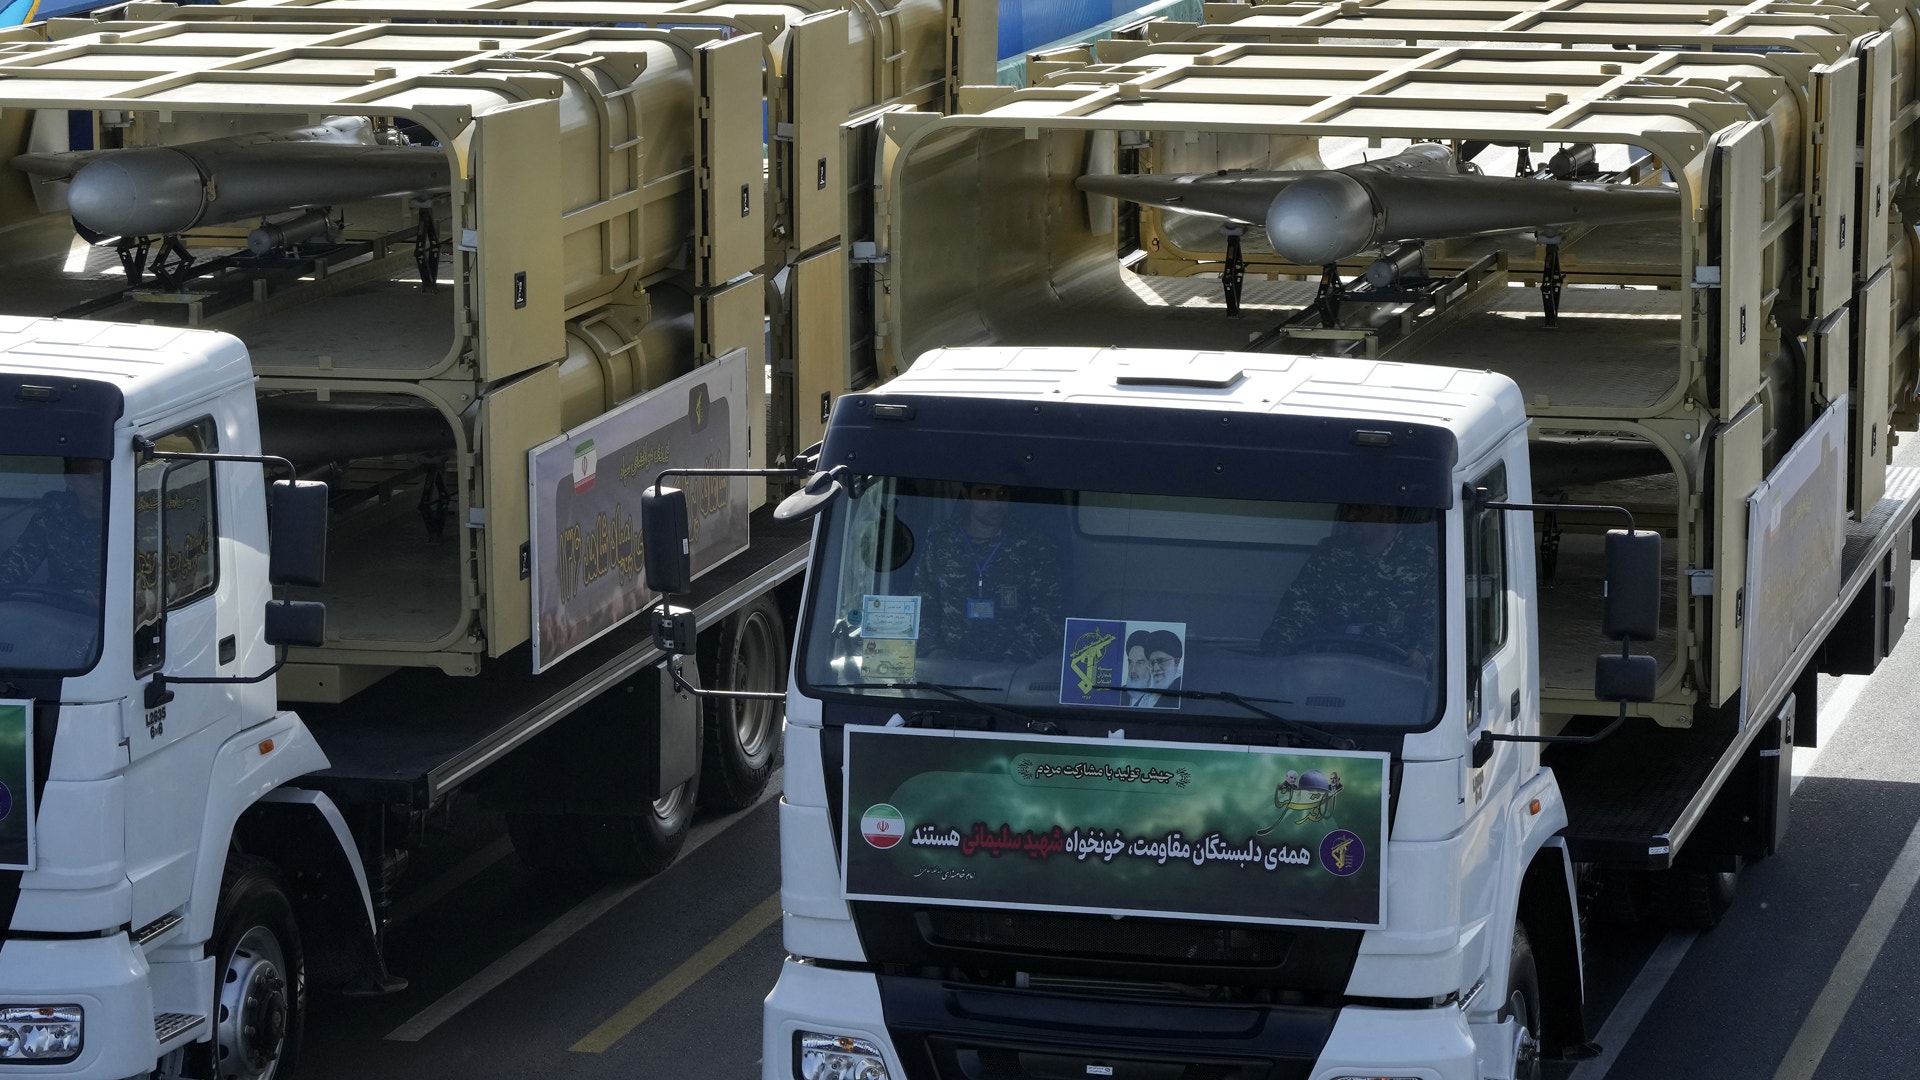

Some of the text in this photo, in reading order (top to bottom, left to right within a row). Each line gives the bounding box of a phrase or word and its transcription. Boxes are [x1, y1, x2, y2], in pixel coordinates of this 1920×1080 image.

[619, 454, 632, 486] سپاه
[583, 512, 609, 585] شاهد
[1035, 763, 1174, 783] جهش تولید با مشارکت مردم
[911, 826, 961, 847] هستند
[962, 824, 1022, 855] سلیمانی
[1023, 827, 1064, 857] شهید
[1065, 830, 1126, 861] خونخواه
[1127, 833, 1192, 864] مقاومت،
[1192, 835, 1263, 868] دلبستگان
